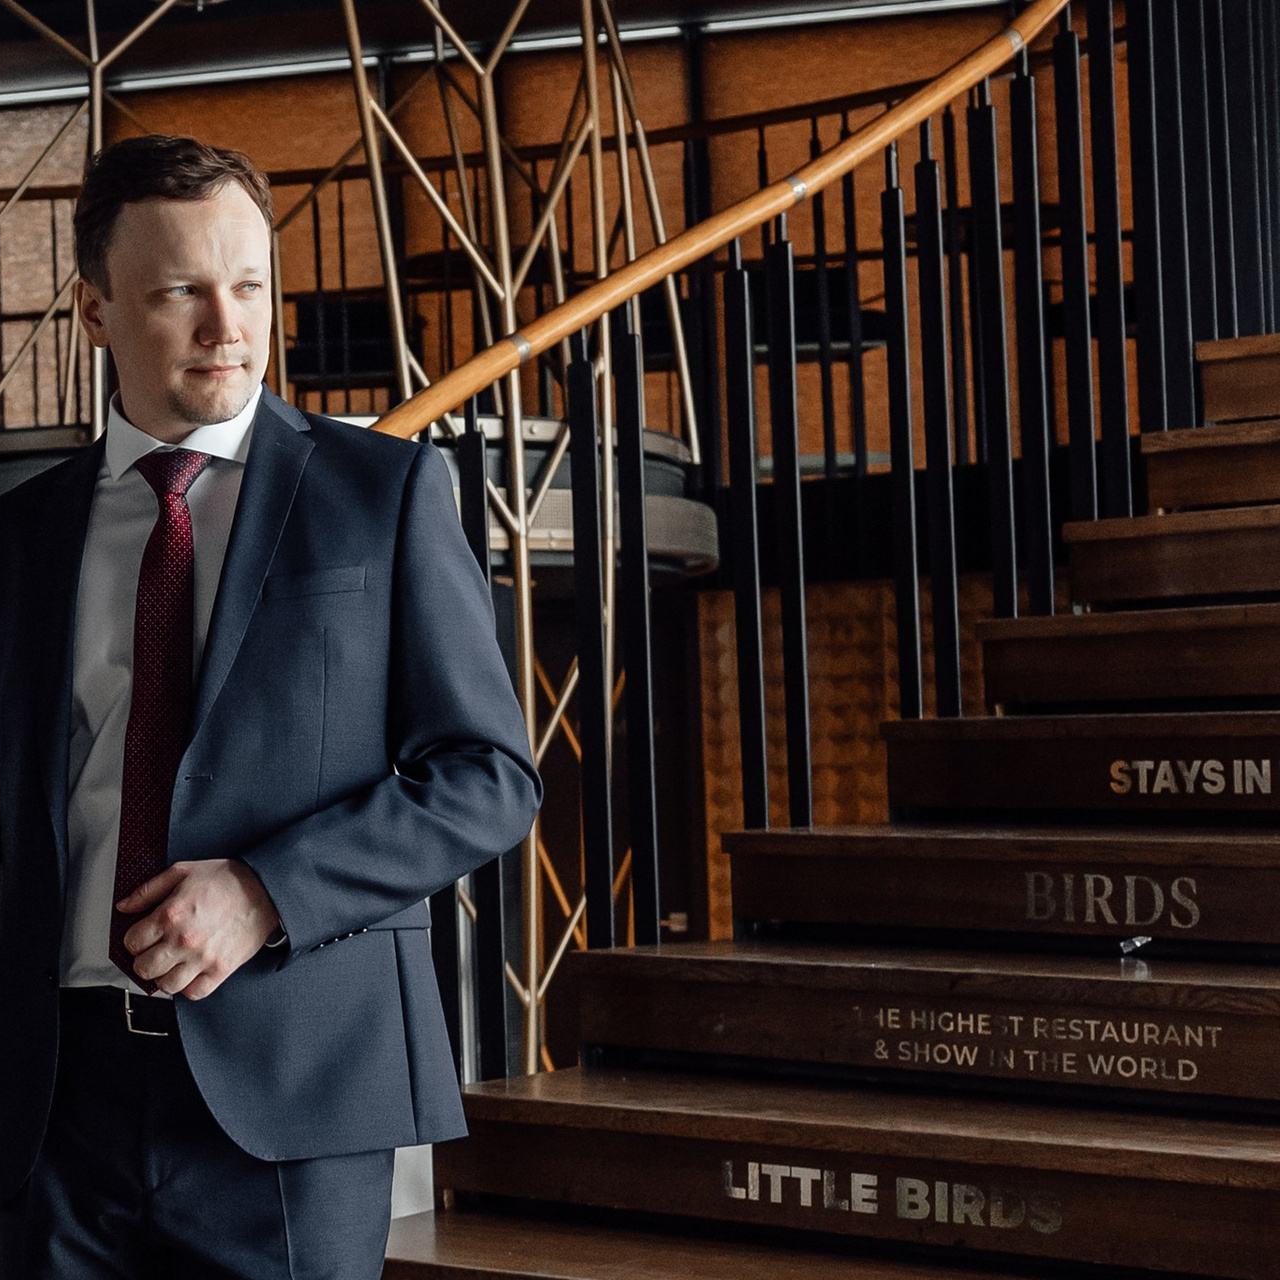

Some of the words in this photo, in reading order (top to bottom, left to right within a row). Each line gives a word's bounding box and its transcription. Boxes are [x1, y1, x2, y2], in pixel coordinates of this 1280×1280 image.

[1109, 759, 1226, 795] STAYS
[1233, 759, 1272, 795] IN
[1023, 870, 1201, 930] BIRDS
[1033, 1017, 1223, 1050] RESTAURANT
[874, 1039, 889, 1061] &
[897, 1041, 979, 1068] SHOW
[1023, 1050, 1078, 1076] THE
[1087, 1055, 1199, 1083] WORLD
[723, 1159, 880, 1216] LITTLE
[895, 1176, 1064, 1236] BIRDS
